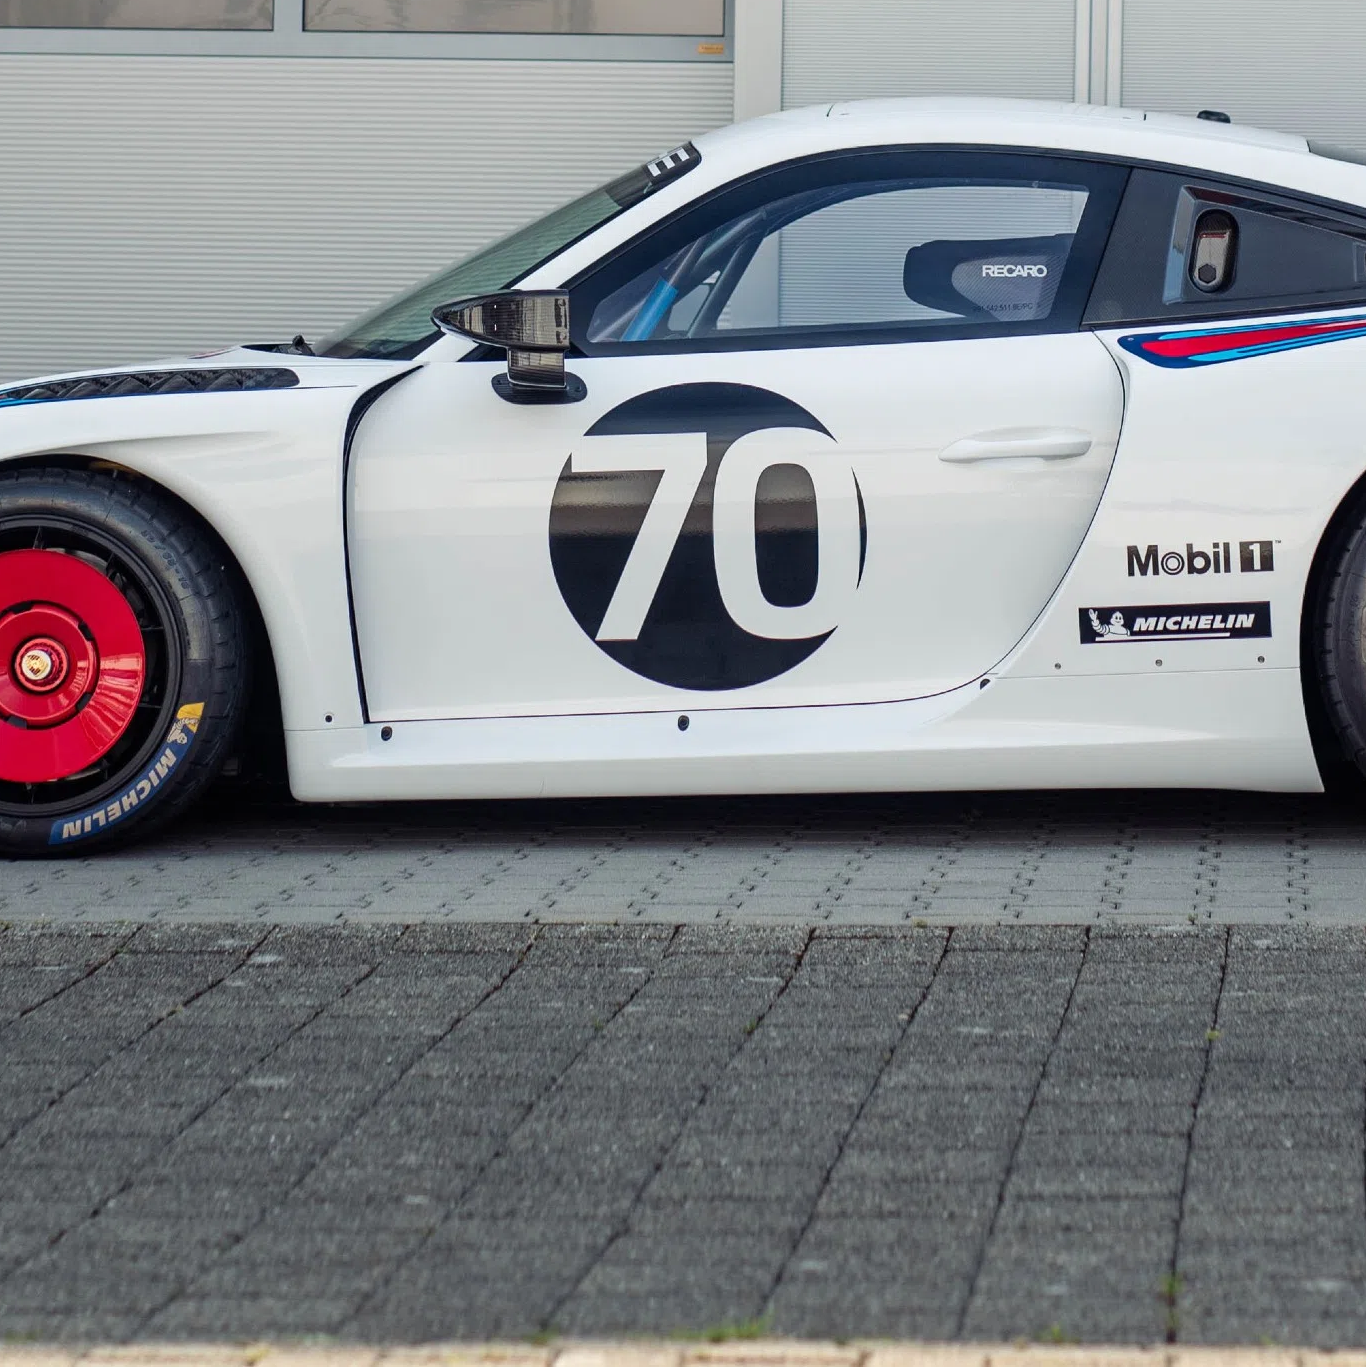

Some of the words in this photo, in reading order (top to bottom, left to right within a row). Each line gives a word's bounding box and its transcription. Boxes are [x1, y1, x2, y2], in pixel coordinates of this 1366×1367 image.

[982, 264, 1048, 278] RECARO
[571, 426, 860, 641] 70
[1127, 542, 1231, 577] Mobil
[1133, 613, 1255, 632] MICHELIN
[62, 748, 177, 839] MICHELIN
